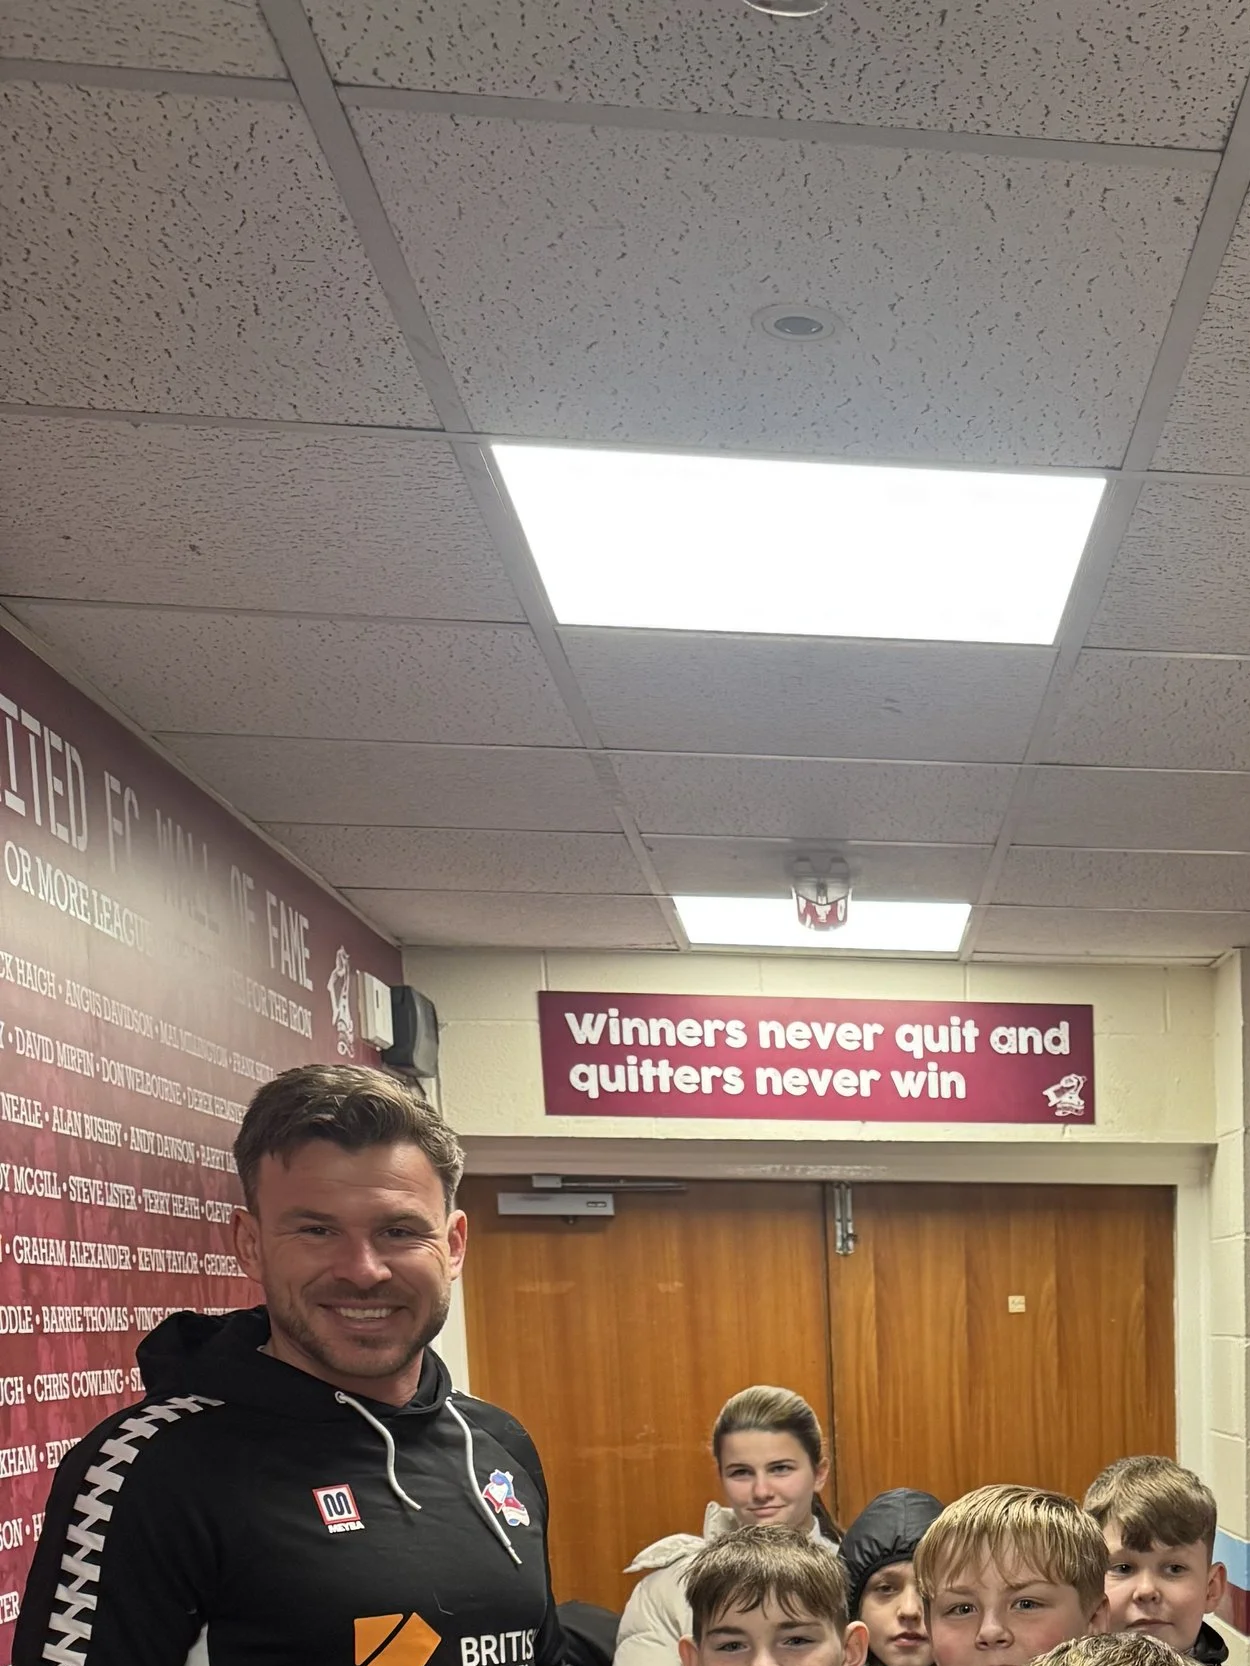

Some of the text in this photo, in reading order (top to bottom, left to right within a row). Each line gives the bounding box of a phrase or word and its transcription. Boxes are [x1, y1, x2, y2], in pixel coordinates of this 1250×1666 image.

[0, 693, 88, 852] ITED
[266, 889, 313, 992] FAME
[4, 840, 35, 896] OR
[35, 856, 91, 926] MORE
[15, 956, 57, 1000] HAIGH
[65, 978, 102, 1020] ANGUS
[102, 995, 153, 1041] DAVIDSON
[565, 1008, 1071, 1060] Winners never quit and
[14, 1026, 55, 1064] DAVID
[55, 1041, 95, 1079] MIRFIN
[100, 1057, 125, 1089] DON
[125, 1065, 183, 1106] WELBOURNE
[569, 1055, 967, 1100] quitters never win
[51, 1104, 83, 1139] ALAN
[83, 1112, 123, 1148] BUSHBY
[130, 1125, 155, 1157] ANDY
[155, 1132, 195, 1165] DAWSON
[13, 1164, 62, 1200] MCGILL
[68, 1175, 104, 1206] STEVE
[104, 1181, 138, 1211] LISTER
[142, 1188, 172, 1216] TERRY
[171, 1192, 201, 1220] HEATH
[12, 1235, 67, 1267] GRAHAM
[69, 1240, 132, 1271] ALEXANDER
[137, 1247, 166, 1272] KEVIN
[166, 1250, 200, 1275] TAYLOR
[41, 1306, 84, 1334] BARRIE
[84, 1306, 130, 1333] THOMAS
[33, 1372, 71, 1403] CHRIS
[70, 1368, 125, 1399] COWLING
